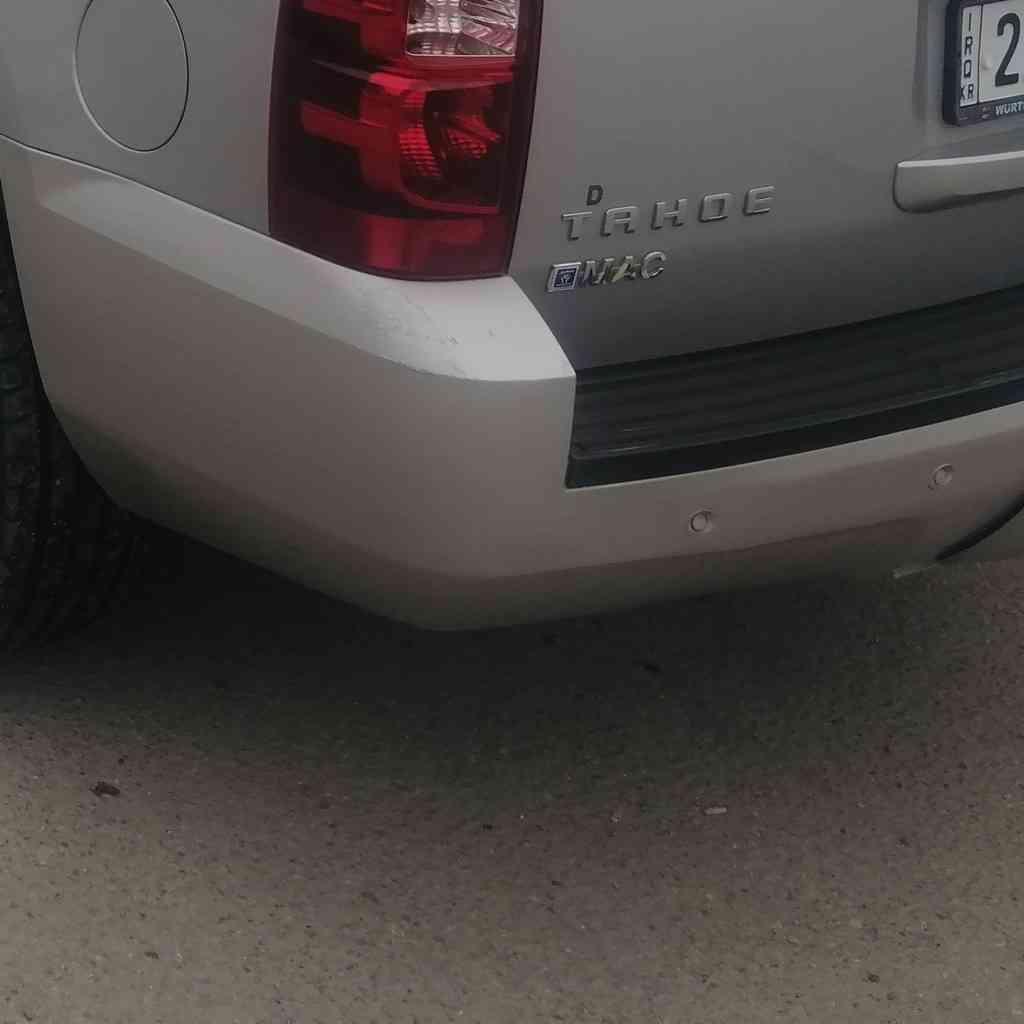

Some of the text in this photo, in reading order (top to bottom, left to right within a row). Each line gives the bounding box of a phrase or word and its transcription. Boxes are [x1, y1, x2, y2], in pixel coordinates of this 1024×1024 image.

[995, 12, 1021, 87] 2
[561, 185, 775, 241] TAHOE
[586, 184, 604, 206] D
